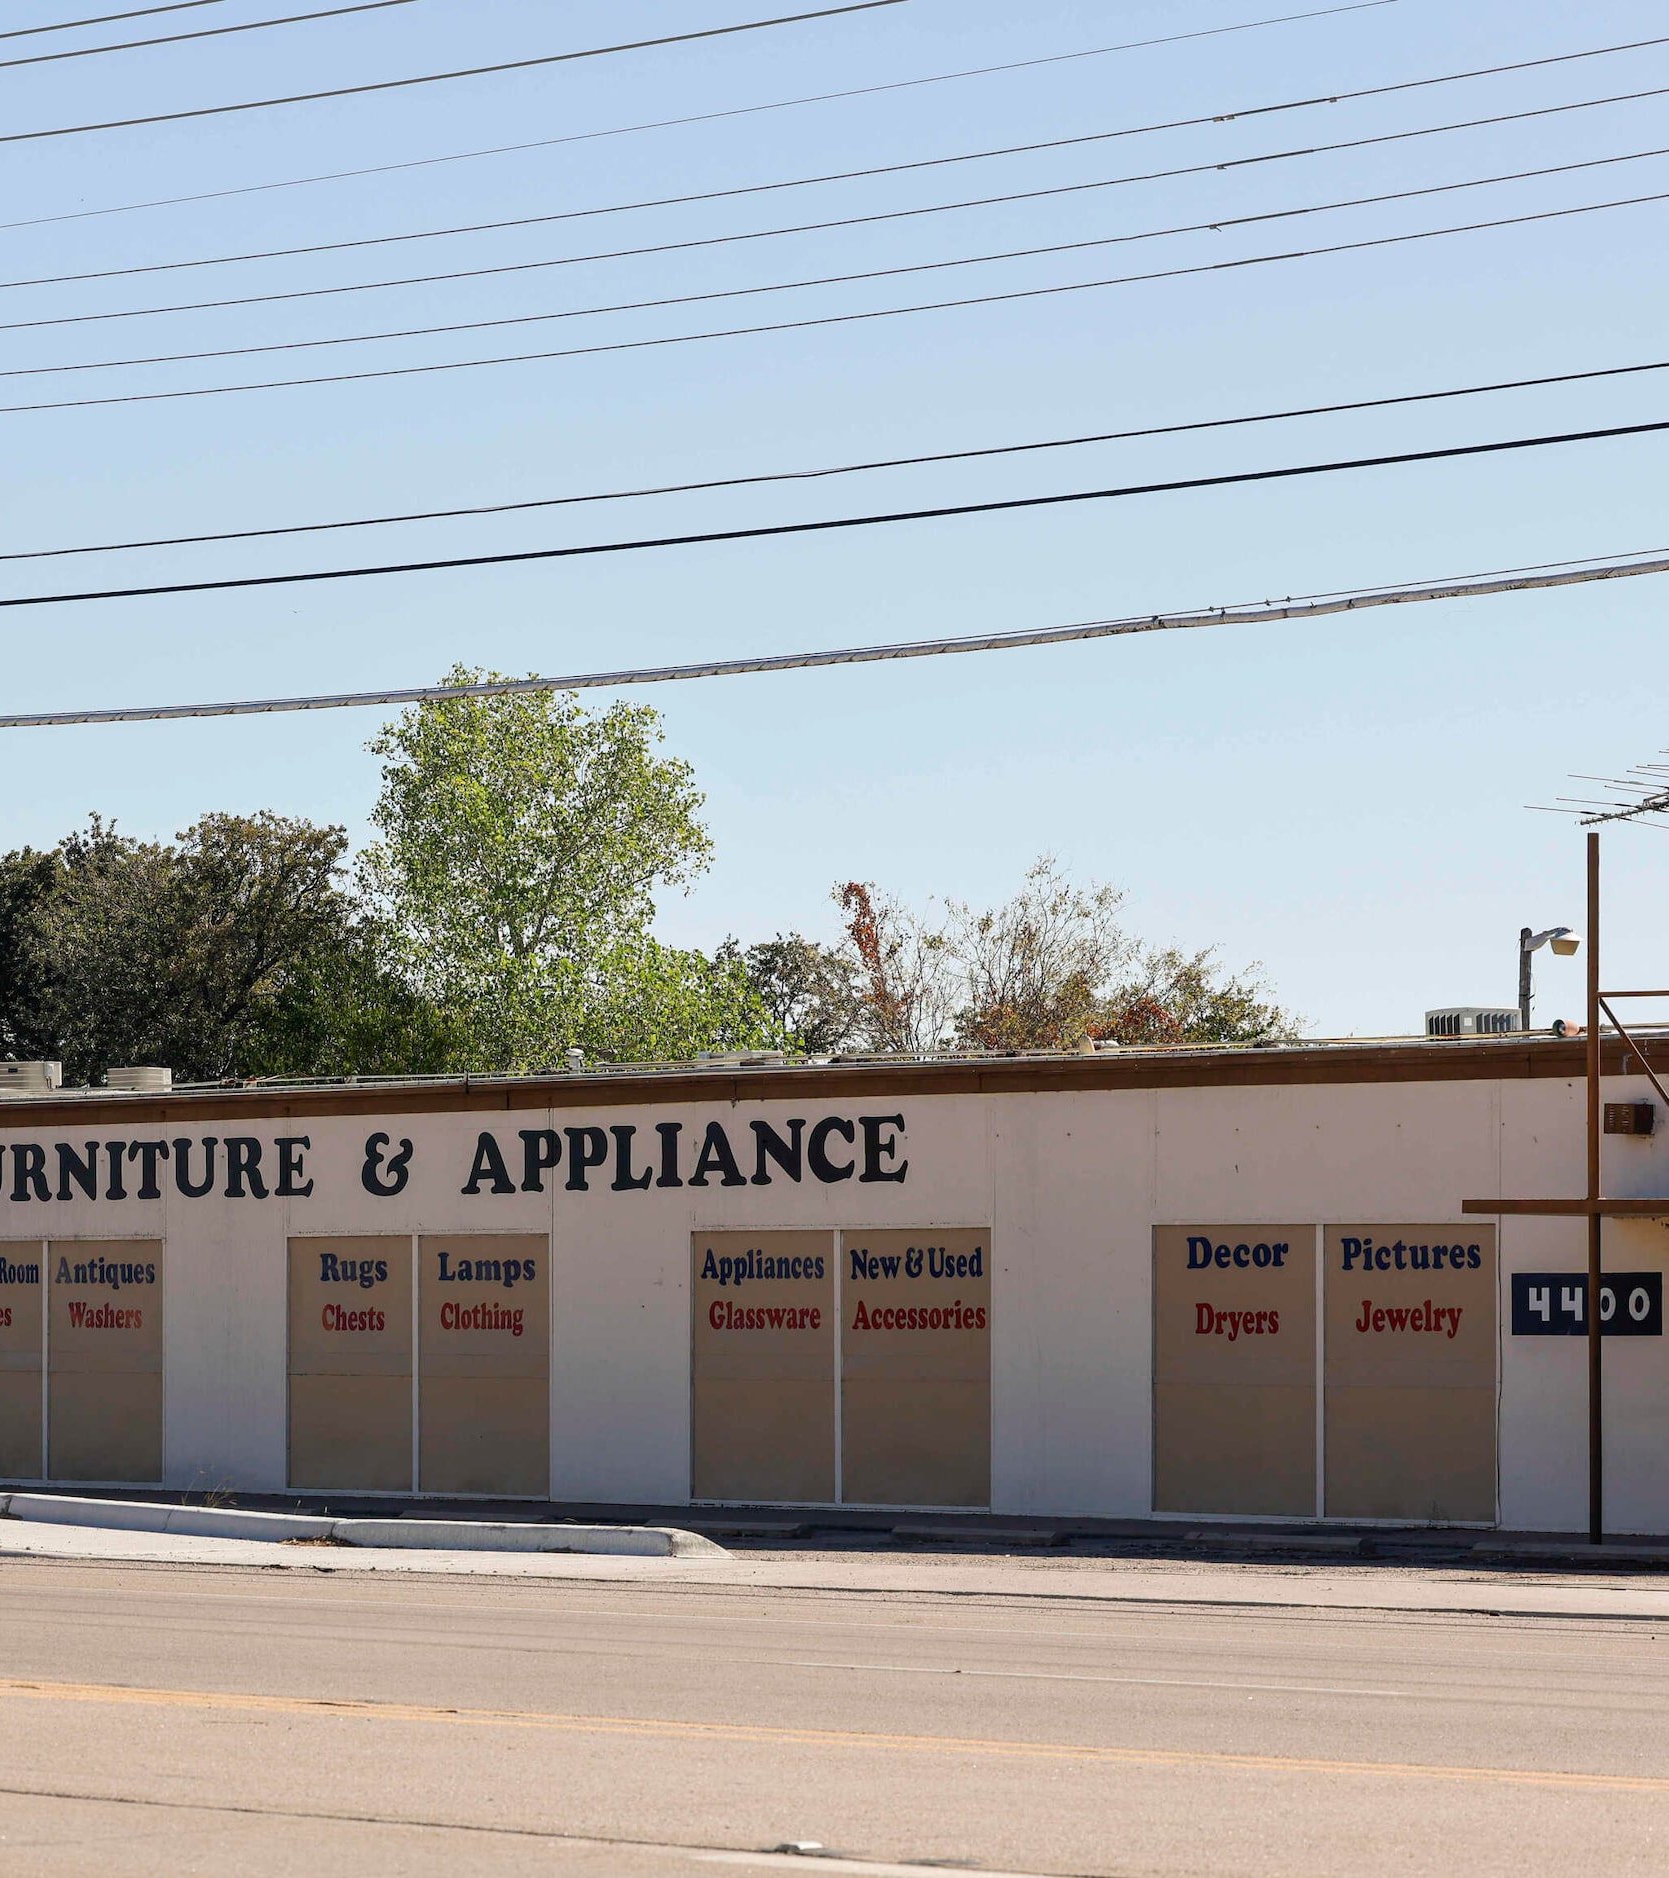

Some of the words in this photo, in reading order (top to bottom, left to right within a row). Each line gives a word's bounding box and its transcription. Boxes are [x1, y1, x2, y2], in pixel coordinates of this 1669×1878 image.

[361, 1132, 413, 1196] &
[461, 1114, 909, 1194] APPLIANCE
[320, 1252, 388, 1288] Rugs
[439, 1252, 535, 1287] Lamps
[701, 1247, 825, 1287] Appliances
[850, 1249, 901, 1279] New
[905, 1247, 924, 1278] &
[929, 1247, 982, 1278] Used
[1187, 1237, 1289, 1269] Decor
[1341, 1238, 1481, 1271] Pictures
[56, 1256, 155, 1290] Antiques
[68, 1302, 142, 1330] Washers
[322, 1304, 385, 1332] Chests
[440, 1302, 524, 1336] Clothing
[709, 1300, 821, 1330] Glassware
[853, 1300, 986, 1330] Accessories
[1356, 1300, 1463, 1339] Jewelry
[1529, 1287, 1650, 1321] 4400
[1195, 1303, 1279, 1341] Dryers
